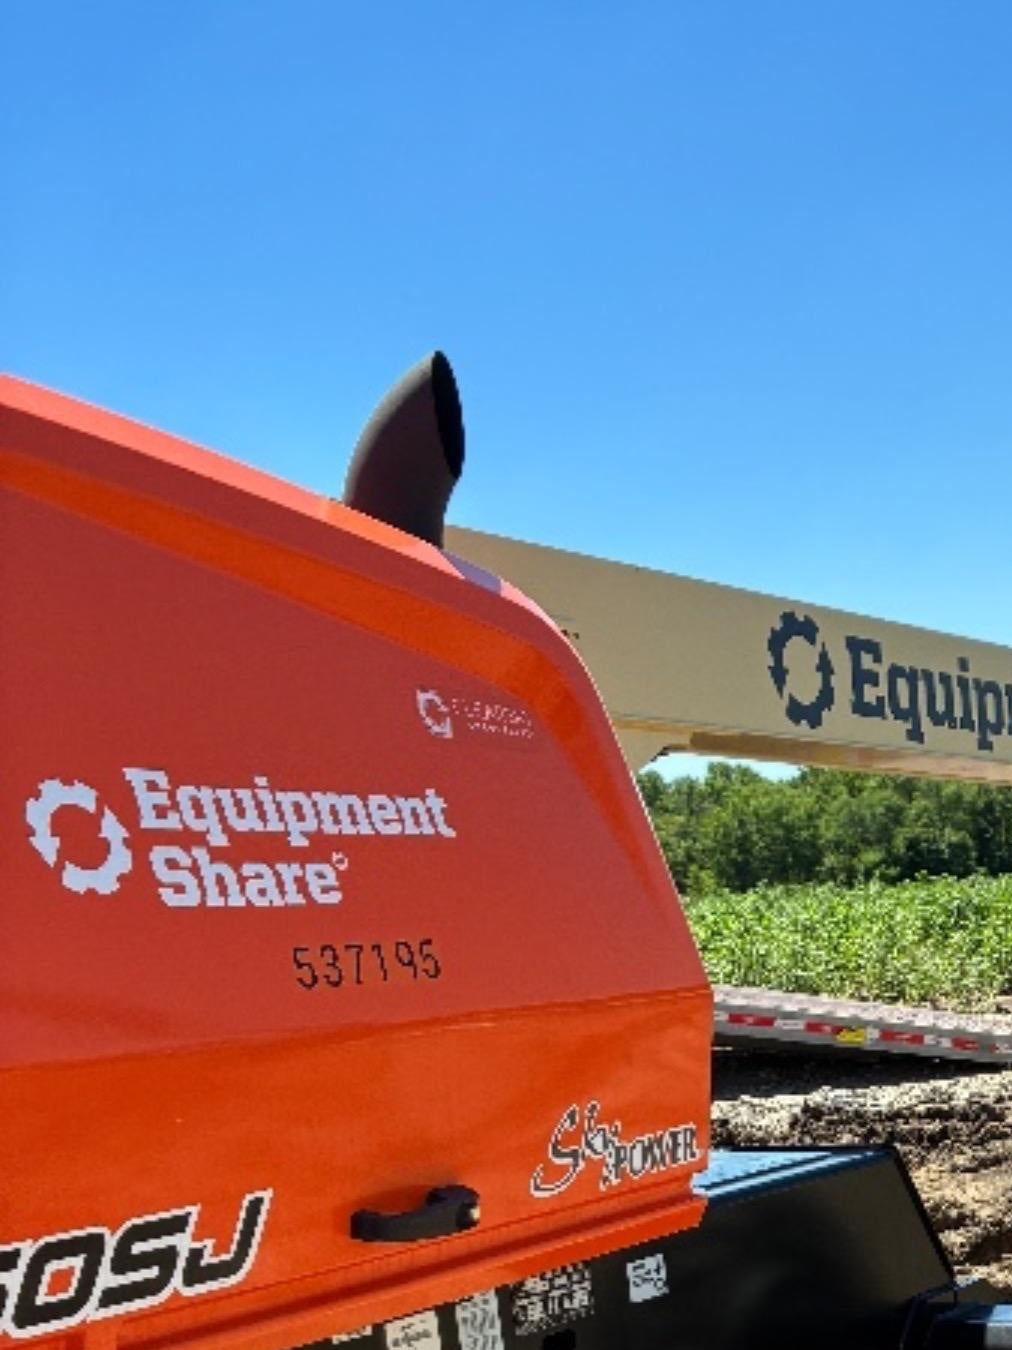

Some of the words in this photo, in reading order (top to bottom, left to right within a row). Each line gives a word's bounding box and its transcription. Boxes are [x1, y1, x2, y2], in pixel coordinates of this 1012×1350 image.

[122, 767, 457, 847] Equipment
[148, 844, 344, 907] Share
[292, 938, 442, 990] 537195
[611, 1122, 700, 1186] POWER
